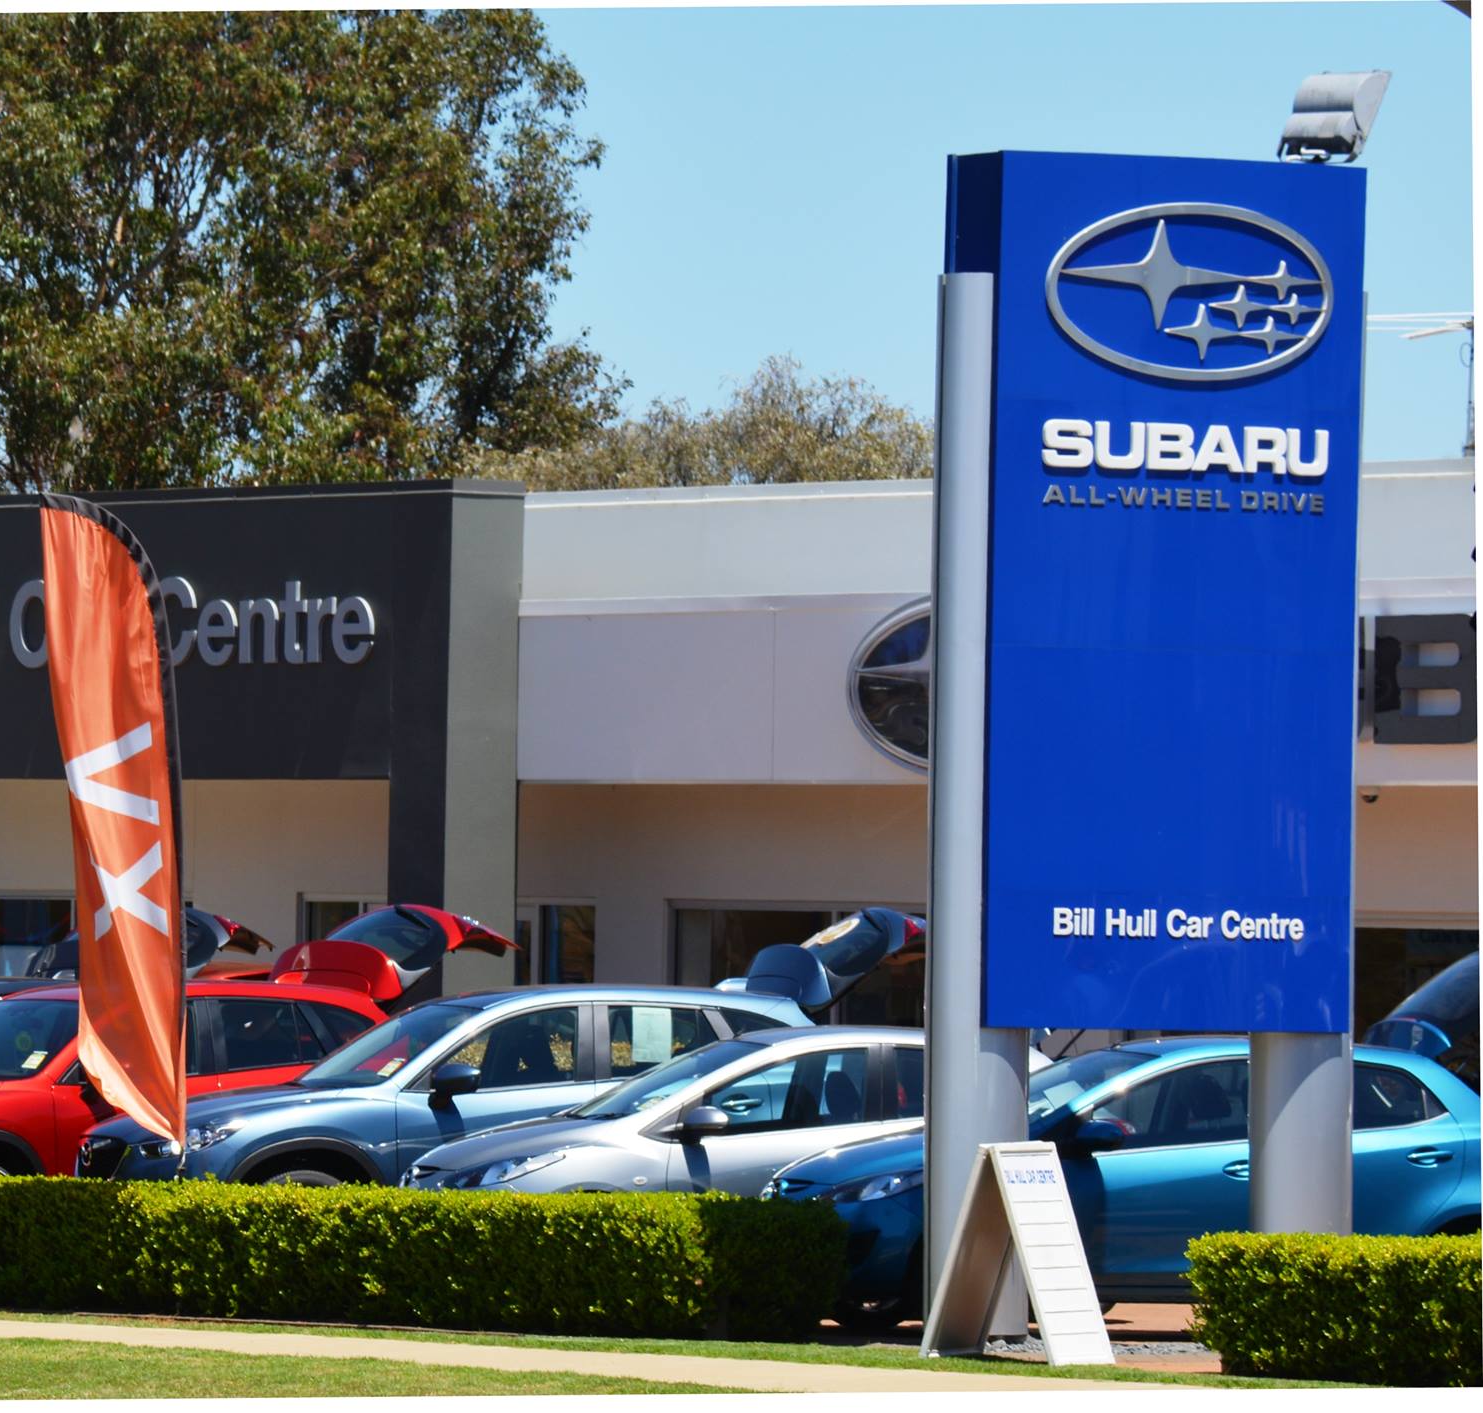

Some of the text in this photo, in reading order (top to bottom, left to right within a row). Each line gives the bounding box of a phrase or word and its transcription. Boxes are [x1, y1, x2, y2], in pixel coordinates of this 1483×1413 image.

[1041, 418, 1330, 478] SUBARU
[1042, 484, 1325, 513] ALL-WHEEL DRIVE
[1053, 907, 1304, 940] Bill Hull Car Centre
